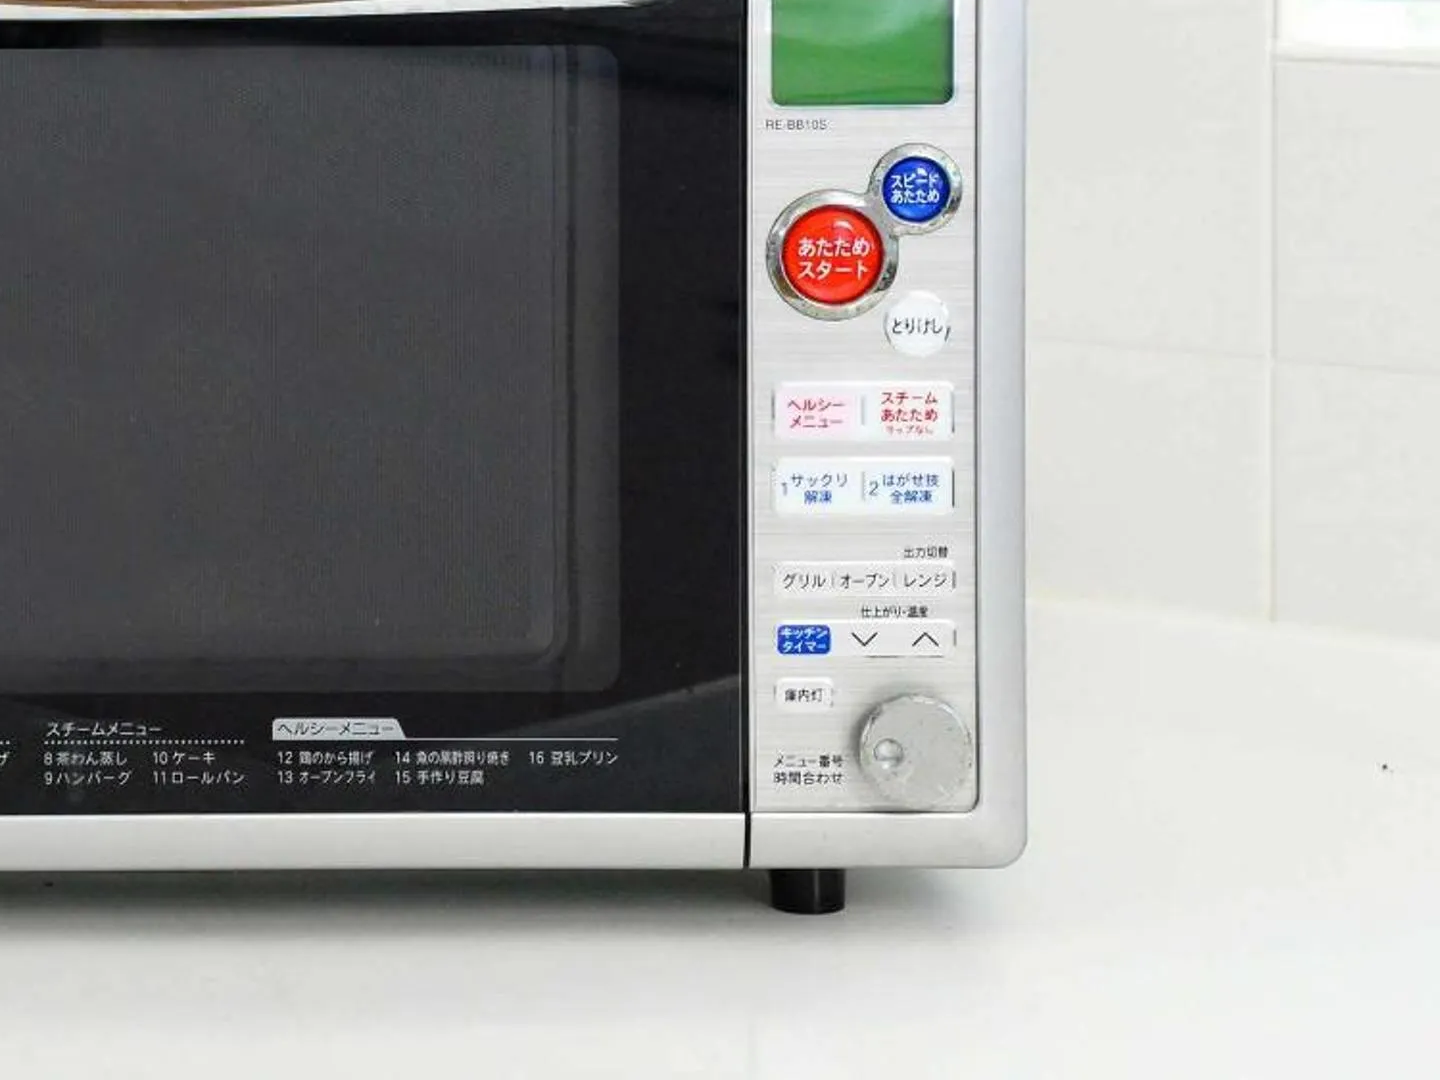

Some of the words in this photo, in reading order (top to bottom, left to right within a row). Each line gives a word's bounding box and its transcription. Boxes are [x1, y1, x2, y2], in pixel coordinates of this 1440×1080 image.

[891, 173, 941, 188] スピード
[891, 189, 940, 204] あたため
[798, 237, 871, 257] あたため
[798, 261, 869, 280] スタート
[892, 318, 943, 335] とりけし
[880, 391, 938, 405] スチーム
[787, 399, 845, 412] ヘルシー
[789, 415, 844, 429] メニュー
[880, 408, 939, 422] あたため
[791, 473, 849, 487] サックリ
[869, 480, 880, 496] 2
[882, 473, 940, 487] はがせ技
[804, 489, 833, 504] 解凍
[890, 489, 933, 504] 全解凍
[904, 546, 949, 559] 出力切替
[782, 573, 826, 589] グリル
[839, 573, 890, 589] オープン
[903, 573, 948, 589] レンジ
[780, 626, 829, 639] キッチン
[781, 639, 827, 653] タイマー
[46, 722, 162, 737] スチームメニュー
[277, 721, 395, 736] ヘルシーメニュー
[44, 752, 53, 765] 8
[153, 752, 169, 765] 10
[172, 751, 216, 765] ケーキ
[278, 751, 293, 764] 12
[395, 751, 410, 764] 14
[529, 751, 544, 765] 16
[774, 754, 844, 768] メニュー番号
[44, 772, 53, 785] 9
[56, 771, 131, 786] ハンバーグ
[153, 771, 167, 785] 11
[171, 771, 245, 785] ロールパン
[278, 771, 294, 784] 13
[299, 771, 376, 785] オープンフライ
[395, 771, 410, 784] 15
[773, 772, 844, 785] 時間合わせ
